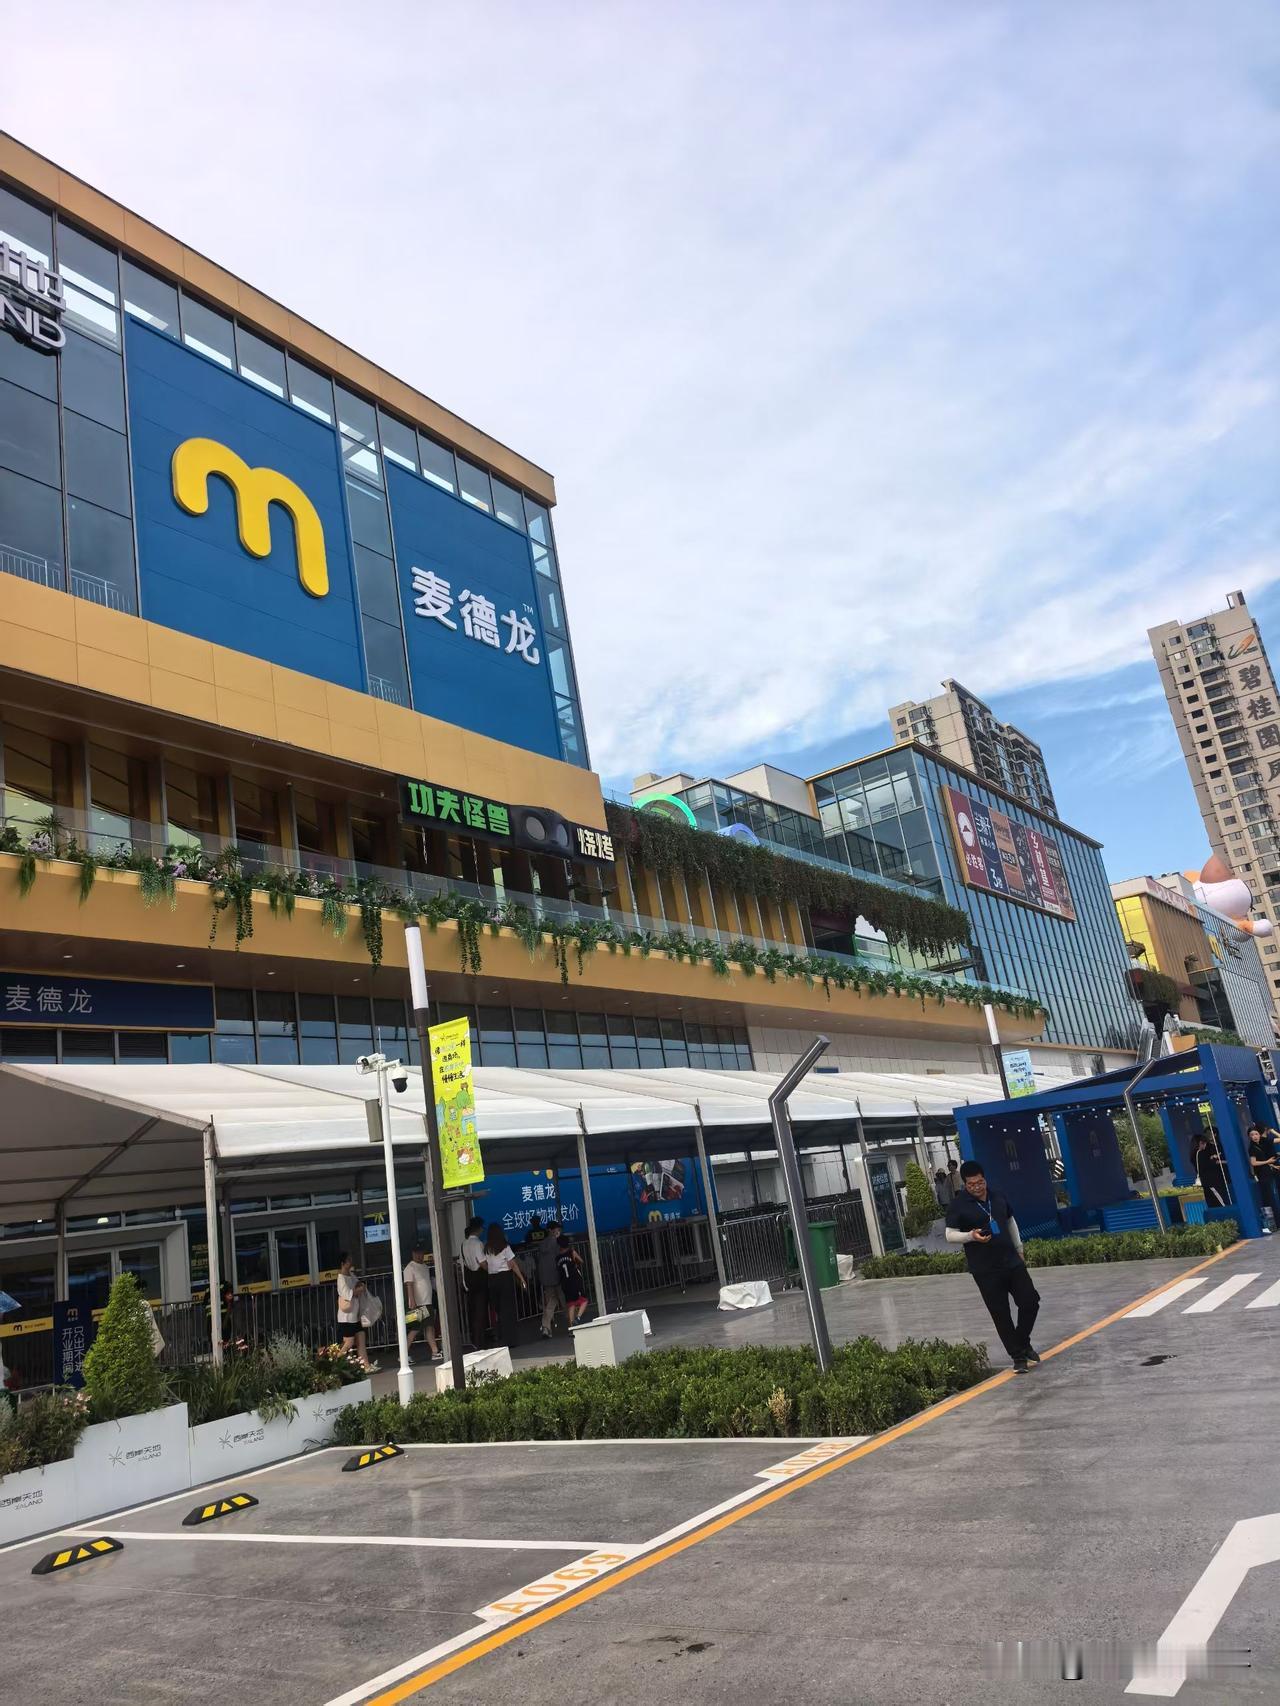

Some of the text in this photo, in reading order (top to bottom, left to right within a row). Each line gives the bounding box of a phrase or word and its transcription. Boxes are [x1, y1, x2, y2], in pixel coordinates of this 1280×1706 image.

[411, 566, 540, 665] 麦德龙
[407, 781, 511, 836] 功夫怪兽
[576, 827, 615, 862] 烧烤
[5, 985, 93, 1014] 麦德龙
[522, 1184, 556, 1202] 麦德龙
[502, 1203, 579, 1230] 全球好物批发价
[562, 1263, 569, 1278] 1
[62, 1327, 74, 1375] 开业期间
[490, 1553, 626, 1615] A069
